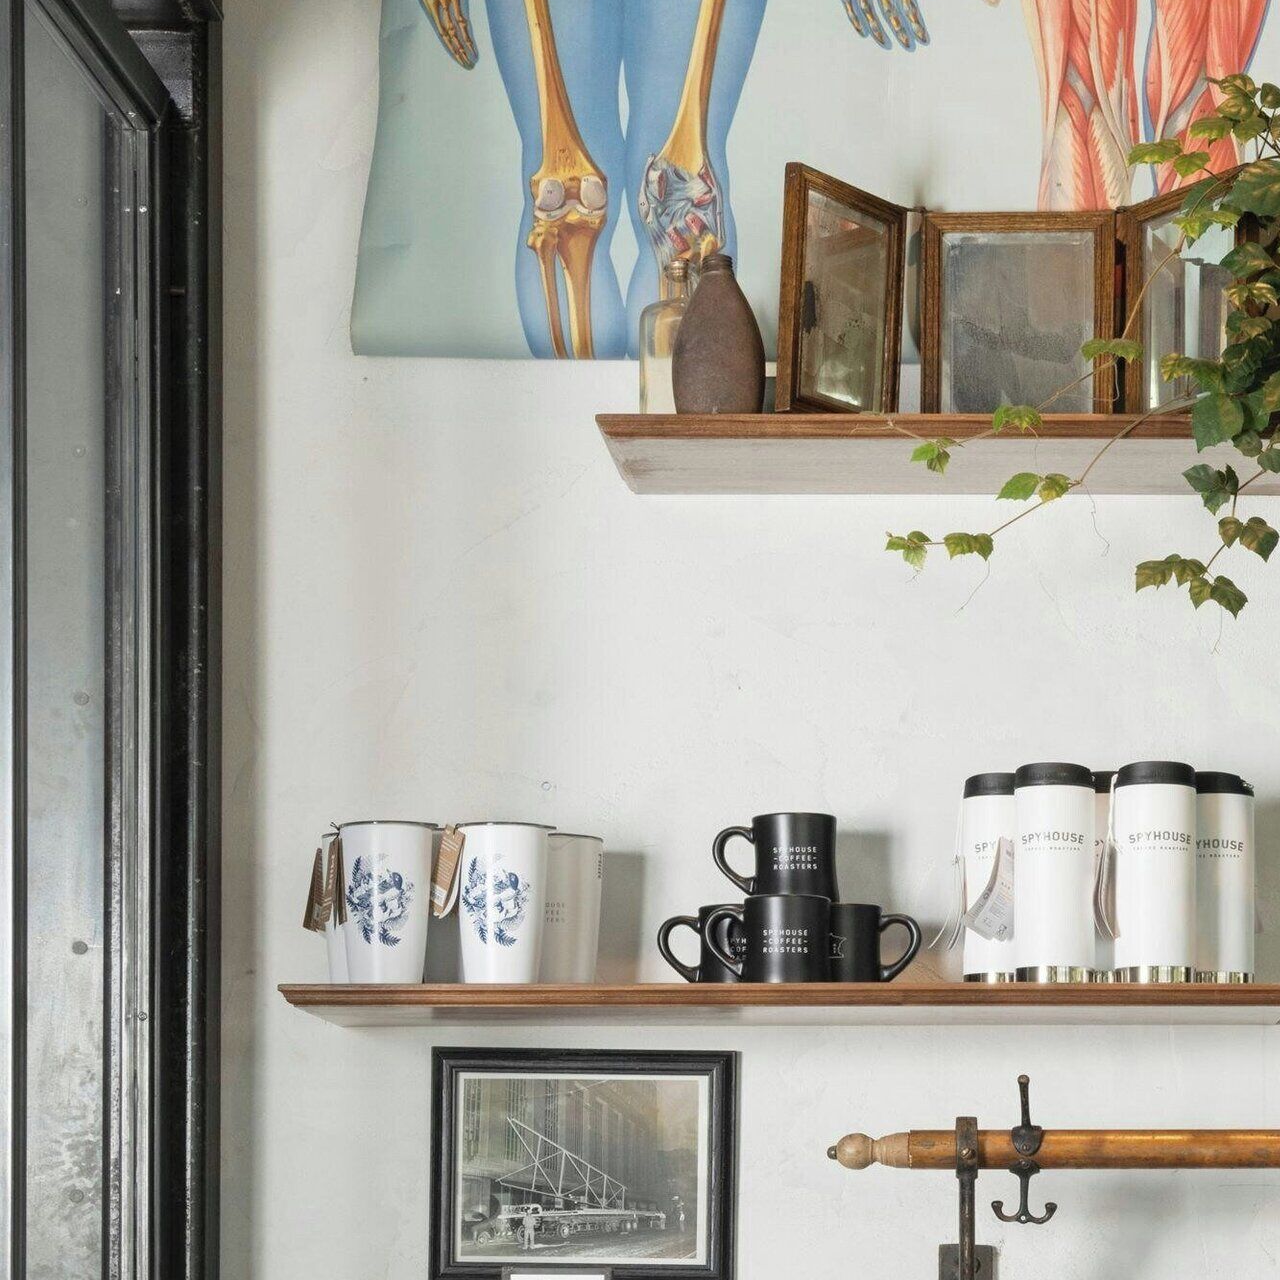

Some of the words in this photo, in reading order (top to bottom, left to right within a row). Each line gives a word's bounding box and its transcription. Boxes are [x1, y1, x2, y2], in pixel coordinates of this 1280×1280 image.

[1021, 831, 1084, 844] SPYHOUSE
[1129, 831, 1191, 844] SPYHOUSE
[1195, 838, 1244, 851] YHOUSE
